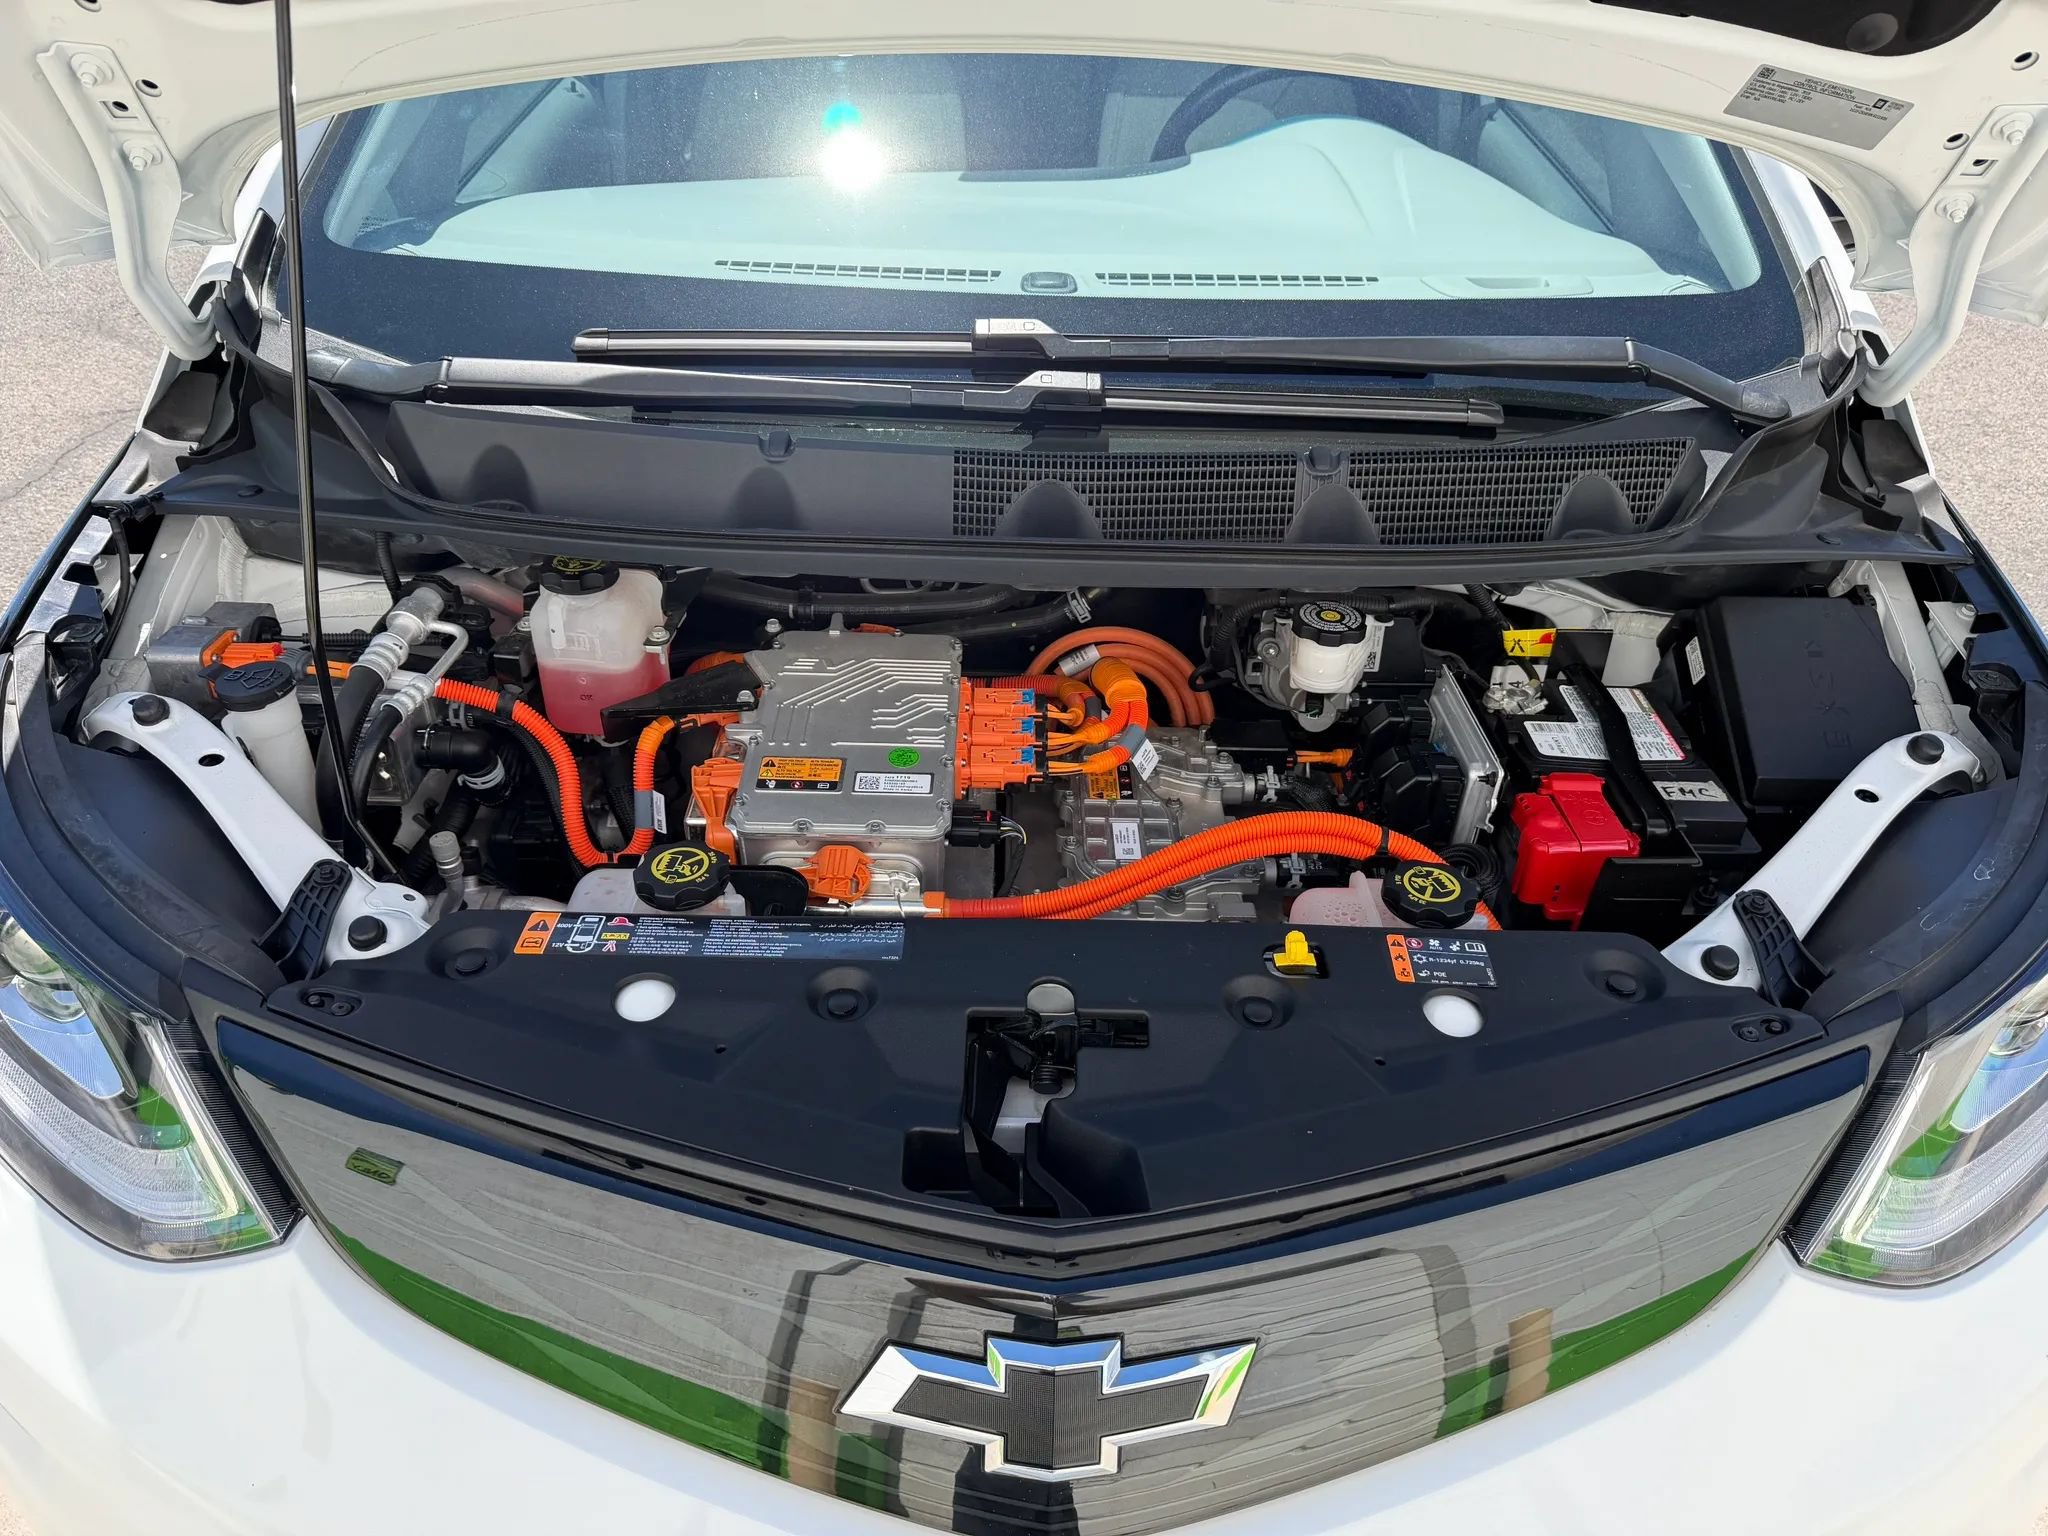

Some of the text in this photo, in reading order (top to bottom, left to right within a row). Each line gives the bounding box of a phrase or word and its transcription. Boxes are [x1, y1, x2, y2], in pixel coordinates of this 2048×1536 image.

[1793, 81, 1856, 100] CONTROL INFORMATION
[1805, 79, 1854, 94] VEHICLE EMISSION
[1661, 786, 1719, 799] FMC
[1429, 957, 1457, 965] R-1234yf
